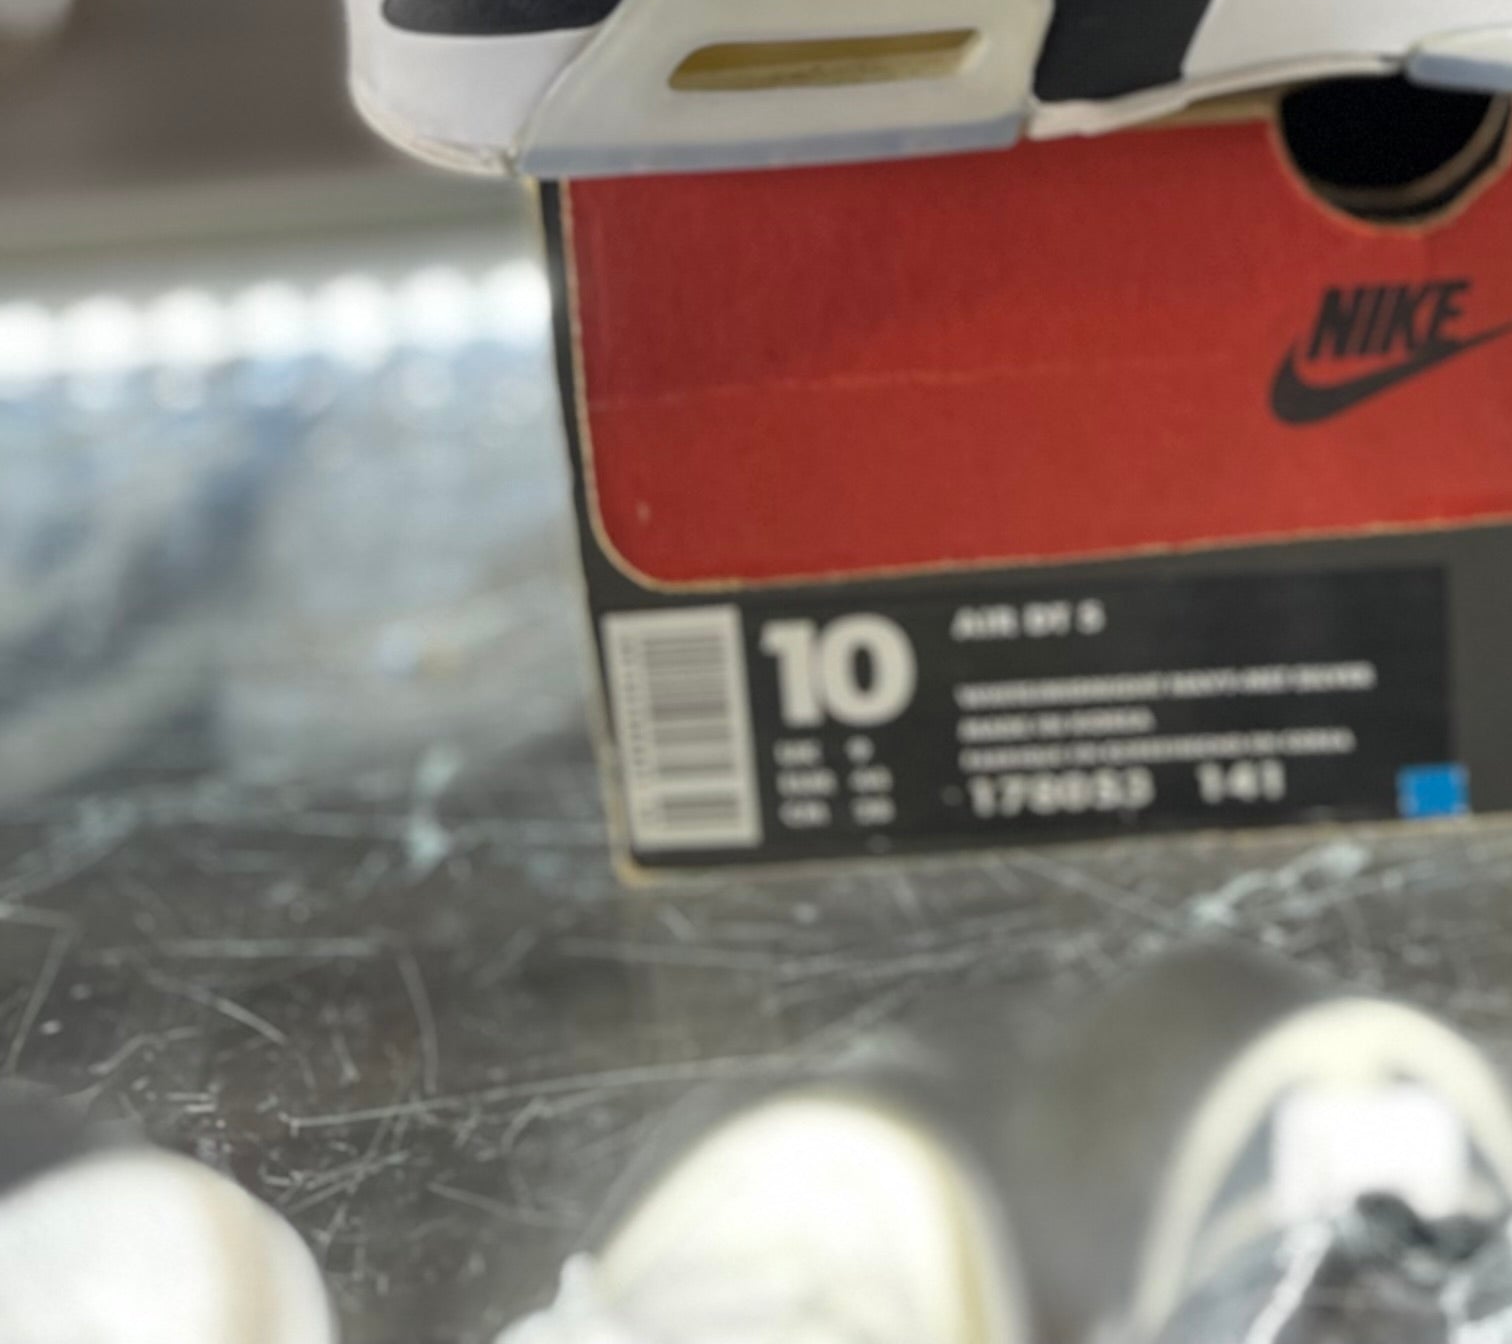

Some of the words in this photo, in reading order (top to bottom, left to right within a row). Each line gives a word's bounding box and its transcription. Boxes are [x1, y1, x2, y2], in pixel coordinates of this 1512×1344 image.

[1305, 278, 1472, 360] NIKE
[952, 608, 1017, 639] AIR
[762, 614, 916, 727] 10
[1198, 761, 1286, 802] 141
